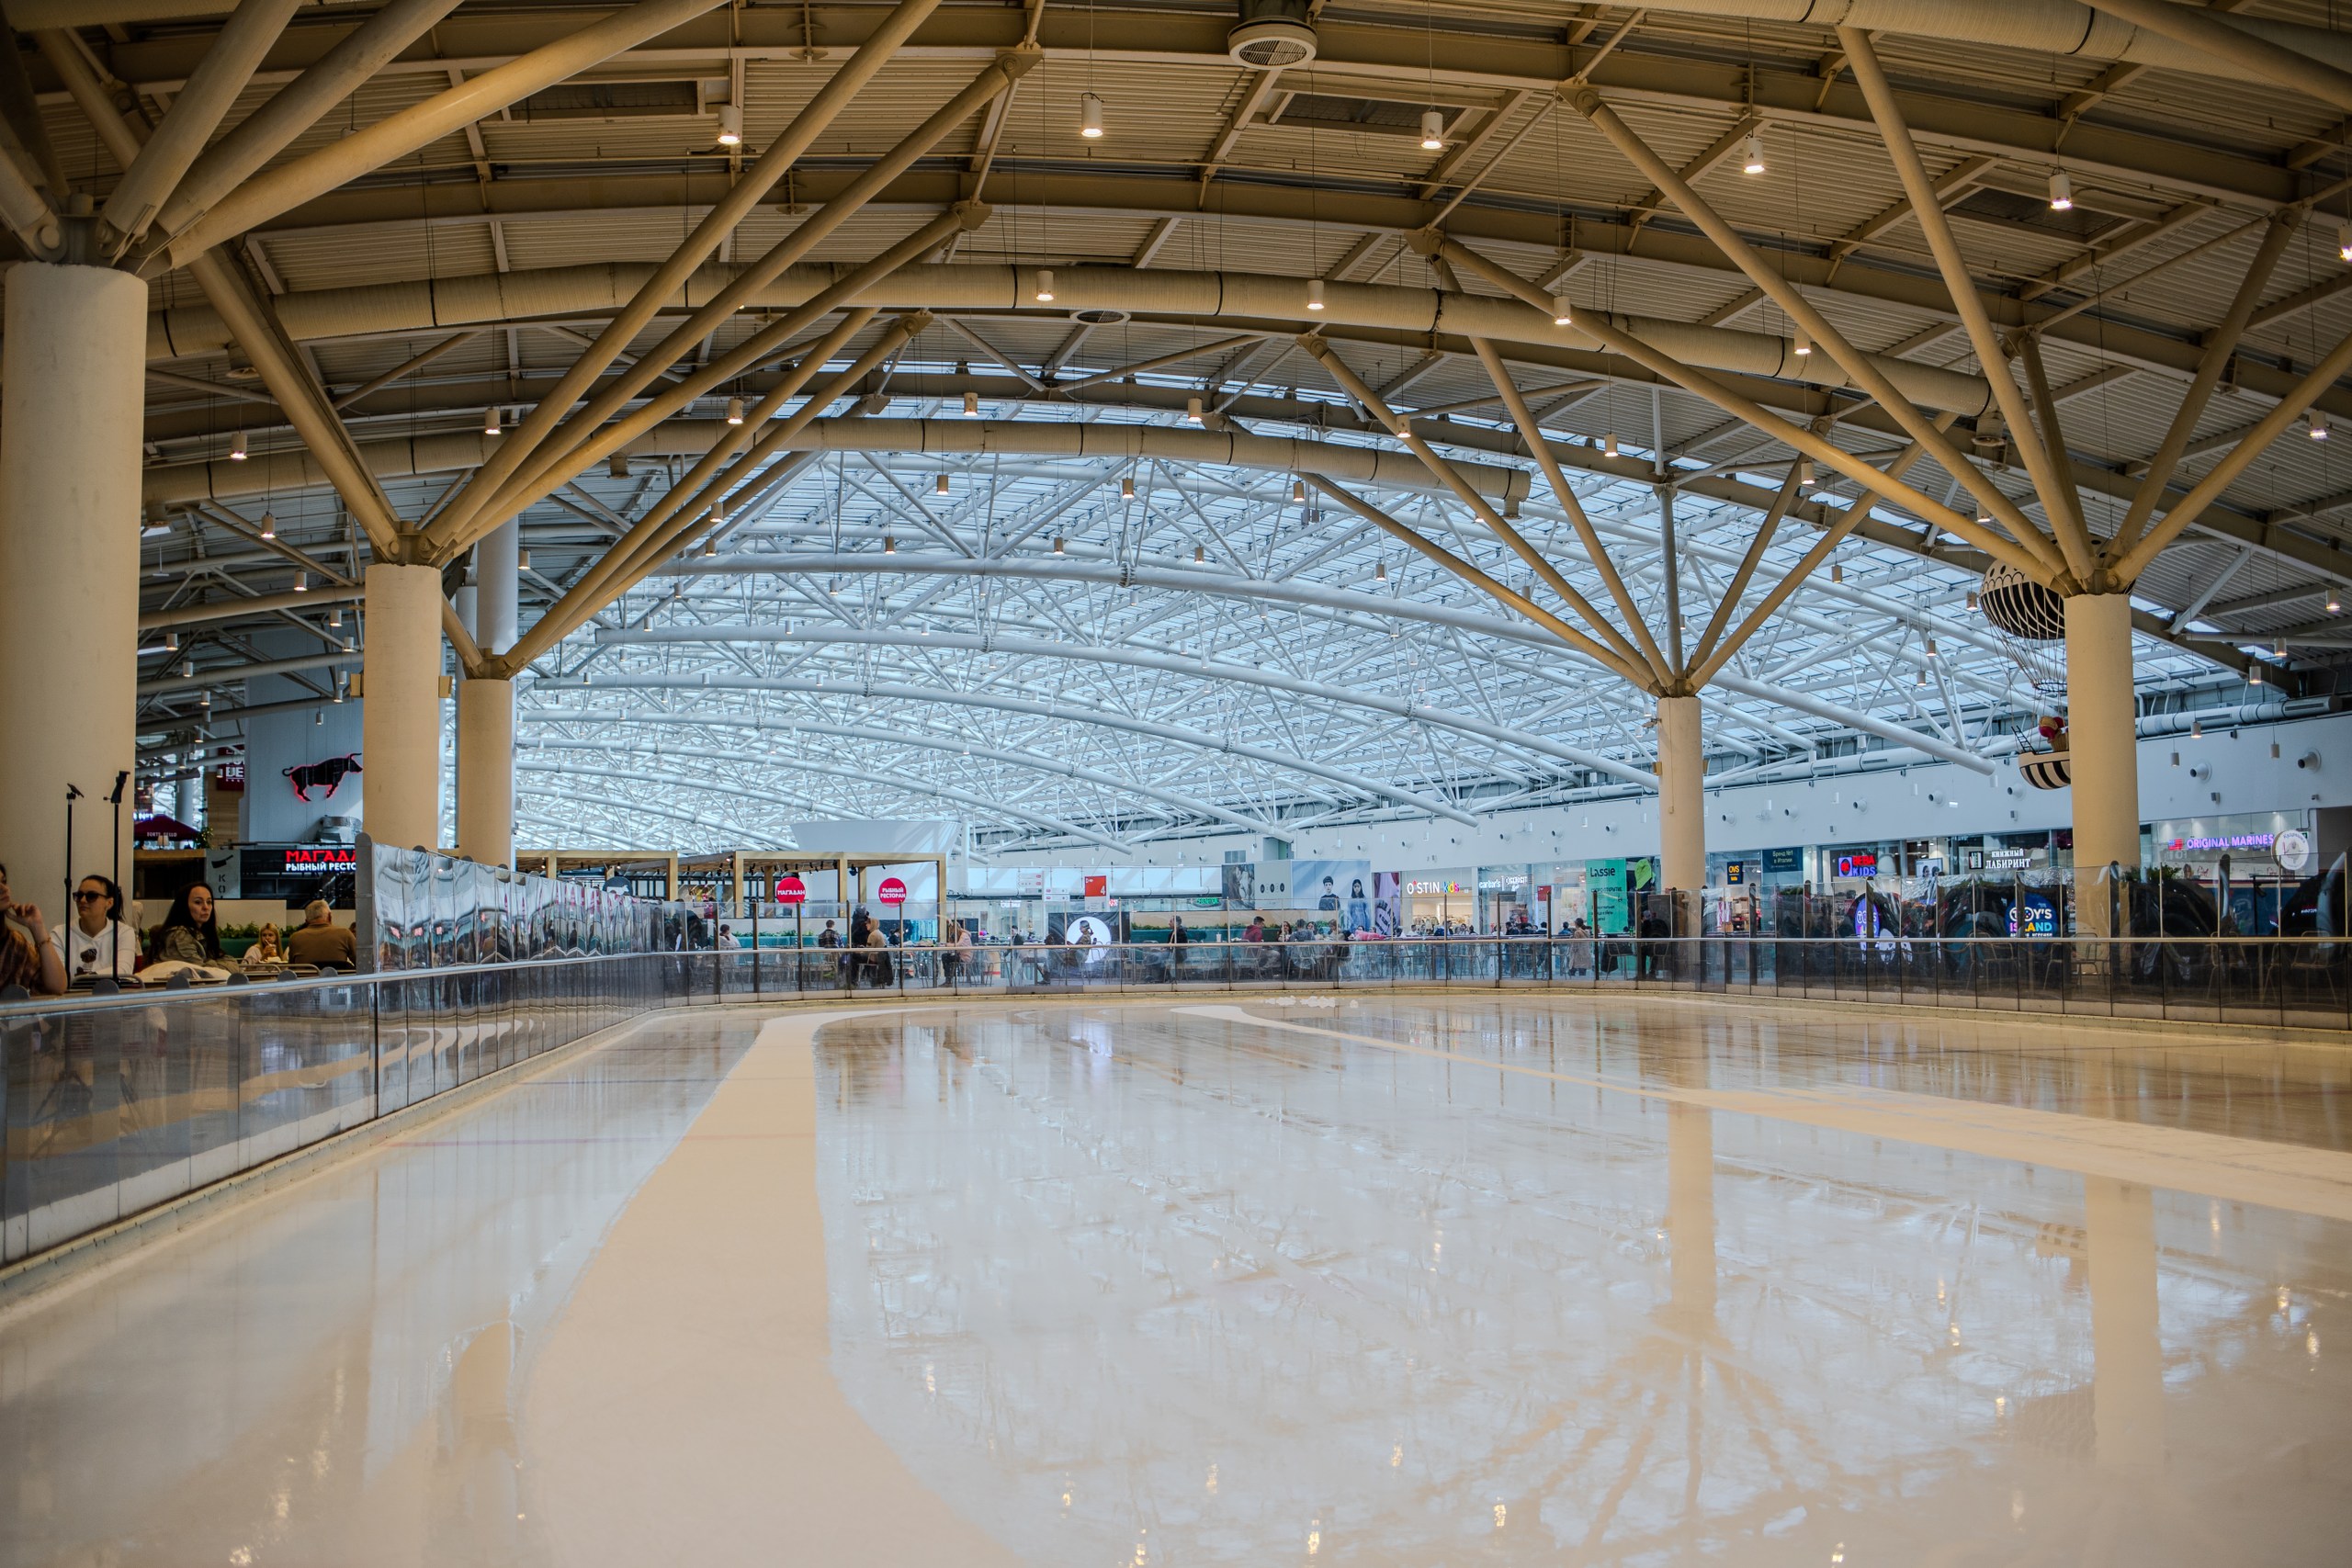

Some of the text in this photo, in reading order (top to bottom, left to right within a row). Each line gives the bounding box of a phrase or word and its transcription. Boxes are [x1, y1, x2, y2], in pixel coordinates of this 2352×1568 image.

[2187, 833, 2275, 851] ORIGINAL MARINES
[1992, 848, 2025, 857] КНИЖНЫЙ
[286, 862, 327, 871] РЫБНЫЙ
[1985, 858, 2030, 869] ЛАБИРИНТ
[1728, 865, 1740, 874] OVS
[1852, 866, 1877, 876] KIDS
[1100, 886, 1106, 896] 4
[1443, 880, 1460, 893] kids
